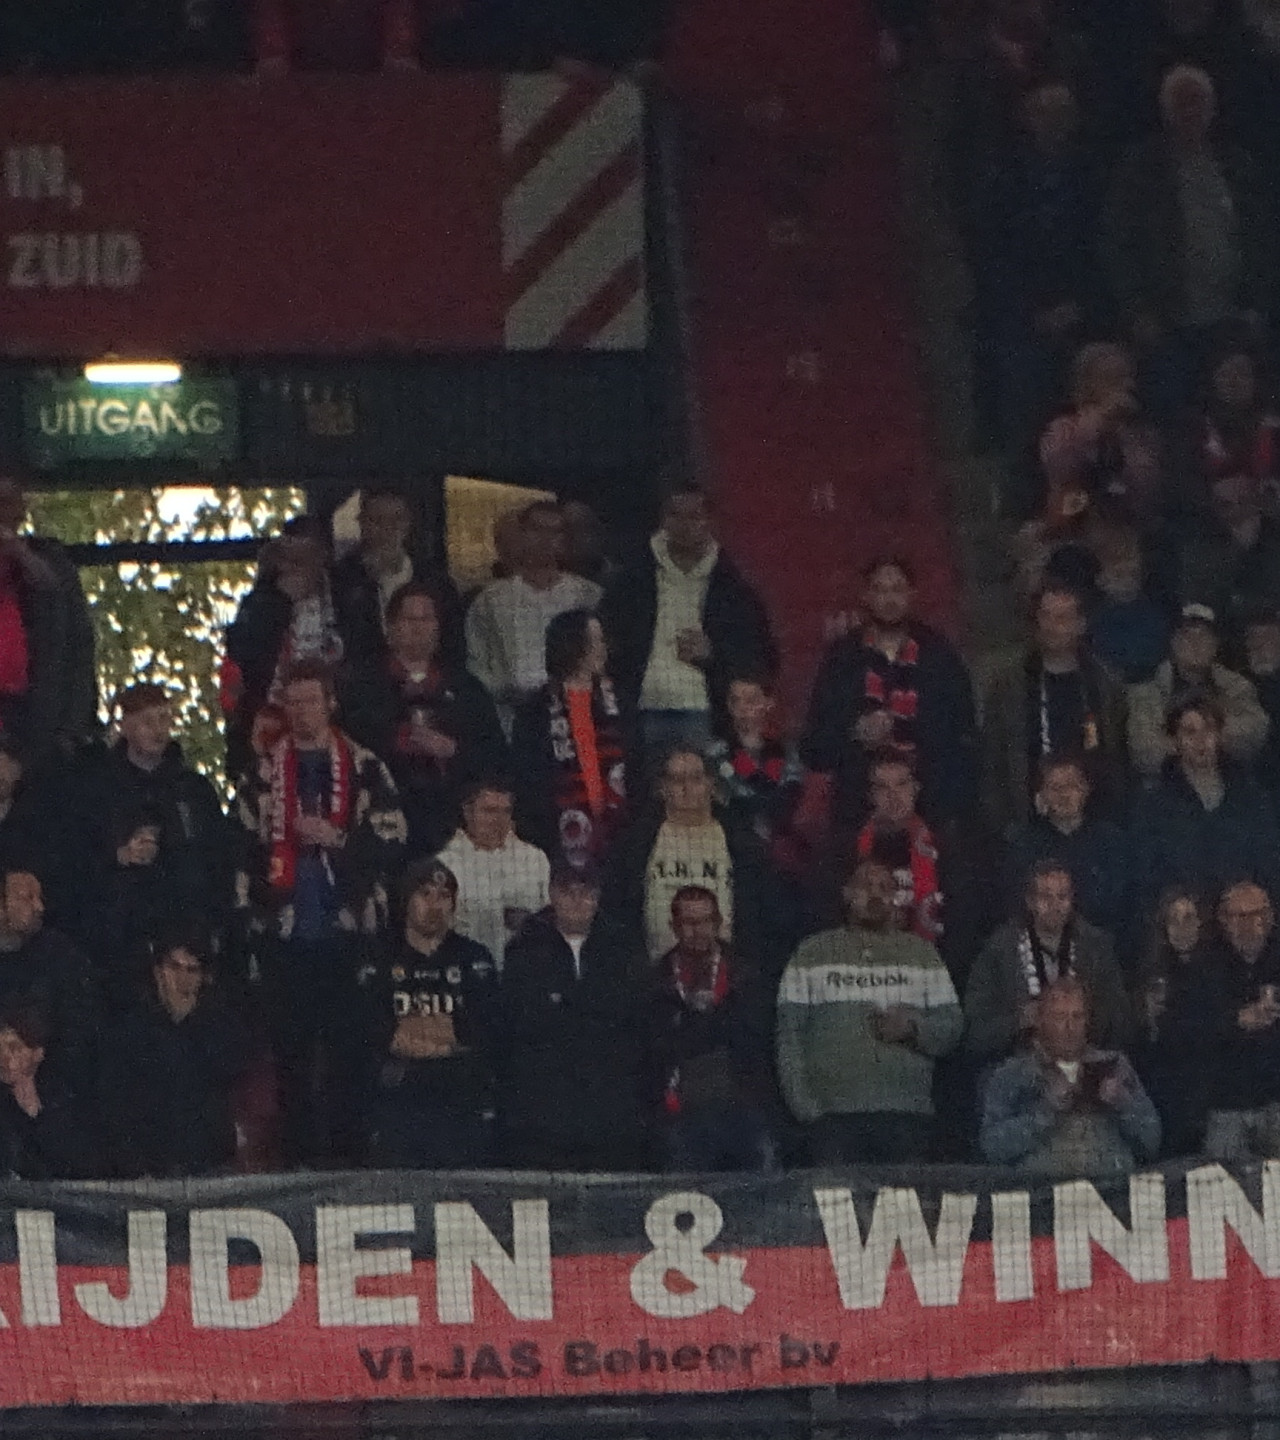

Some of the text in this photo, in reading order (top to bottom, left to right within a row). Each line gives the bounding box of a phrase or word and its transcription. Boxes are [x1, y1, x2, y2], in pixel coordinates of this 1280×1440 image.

[7, 231, 142, 288] ZUID
[38, 397, 222, 437] UITGANG
[631, 1191, 756, 1320] &
[357, 1332, 840, 1382] VI-JAS Beheer bv
